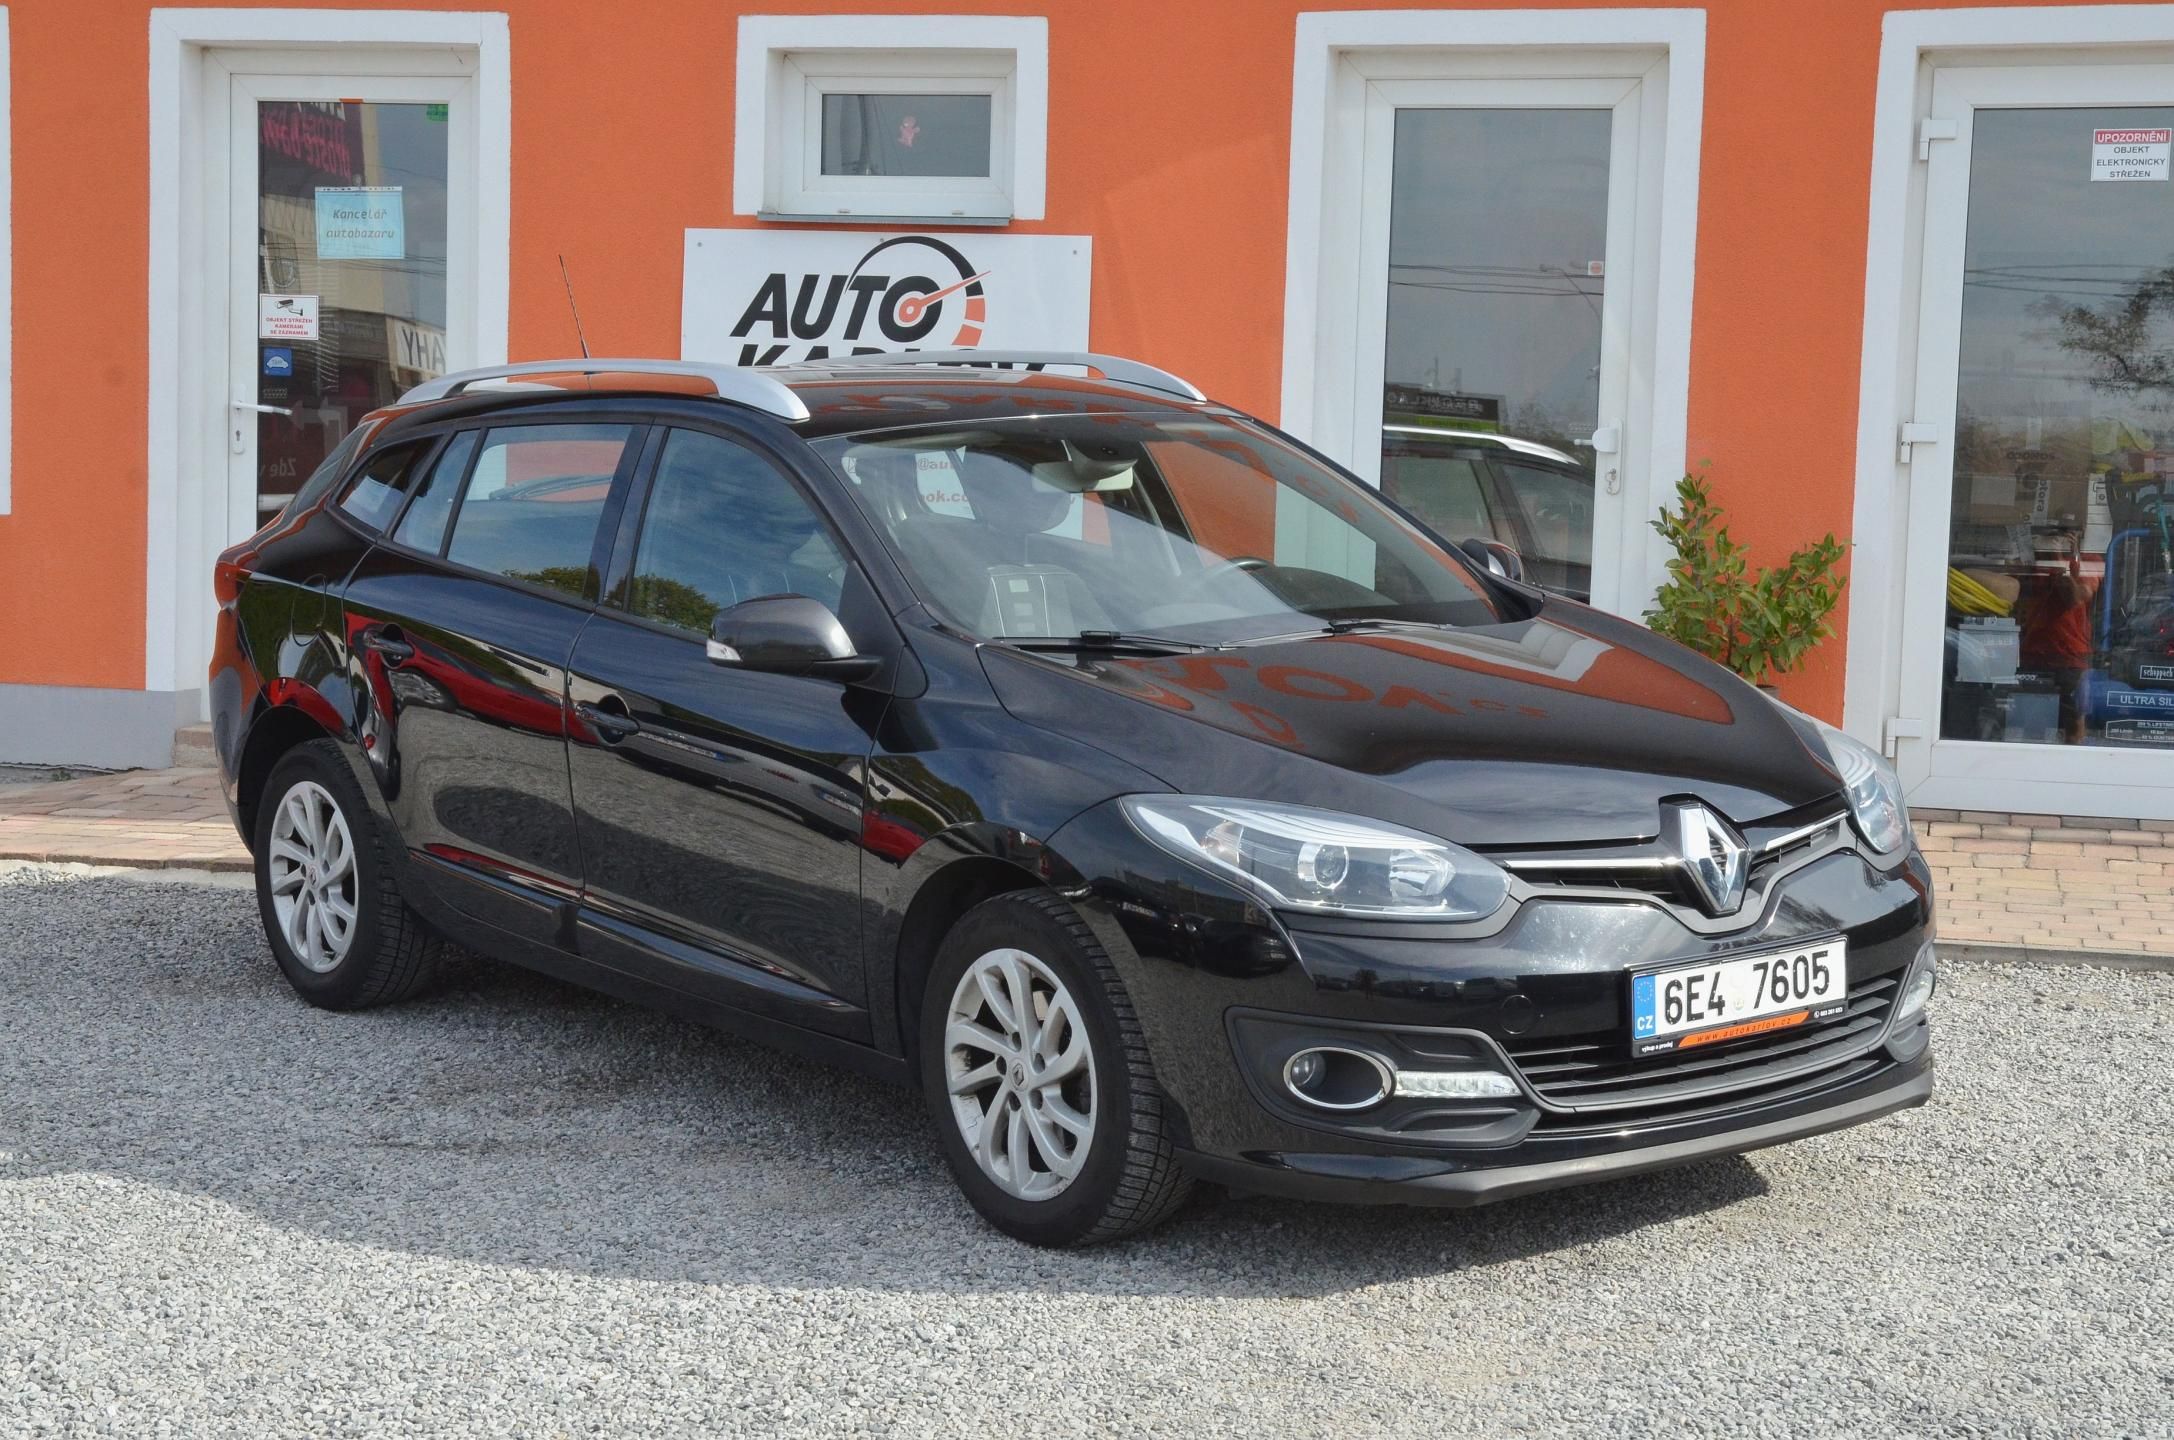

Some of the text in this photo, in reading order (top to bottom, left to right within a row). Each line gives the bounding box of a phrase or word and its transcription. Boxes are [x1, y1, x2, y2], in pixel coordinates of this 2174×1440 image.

[2097, 130, 2168, 143] UPOZORNĚNÍ
[2113, 146, 2150, 154] OBJEKT
[2096, 158, 2166, 167] ELEKTRONICKY
[2109, 169, 2151, 178] STŘEŽEN
[332, 208, 388, 220] Kancelář
[326, 228, 394, 239] autobazaru
[729, 273, 944, 343] AUTO
[918, 457, 955, 471] @au
[2120, 695, 2156, 705] ULTRA
[1664, 950, 1830, 1026] 6E4 7605
[1637, 1015, 1653, 1031] CZ
